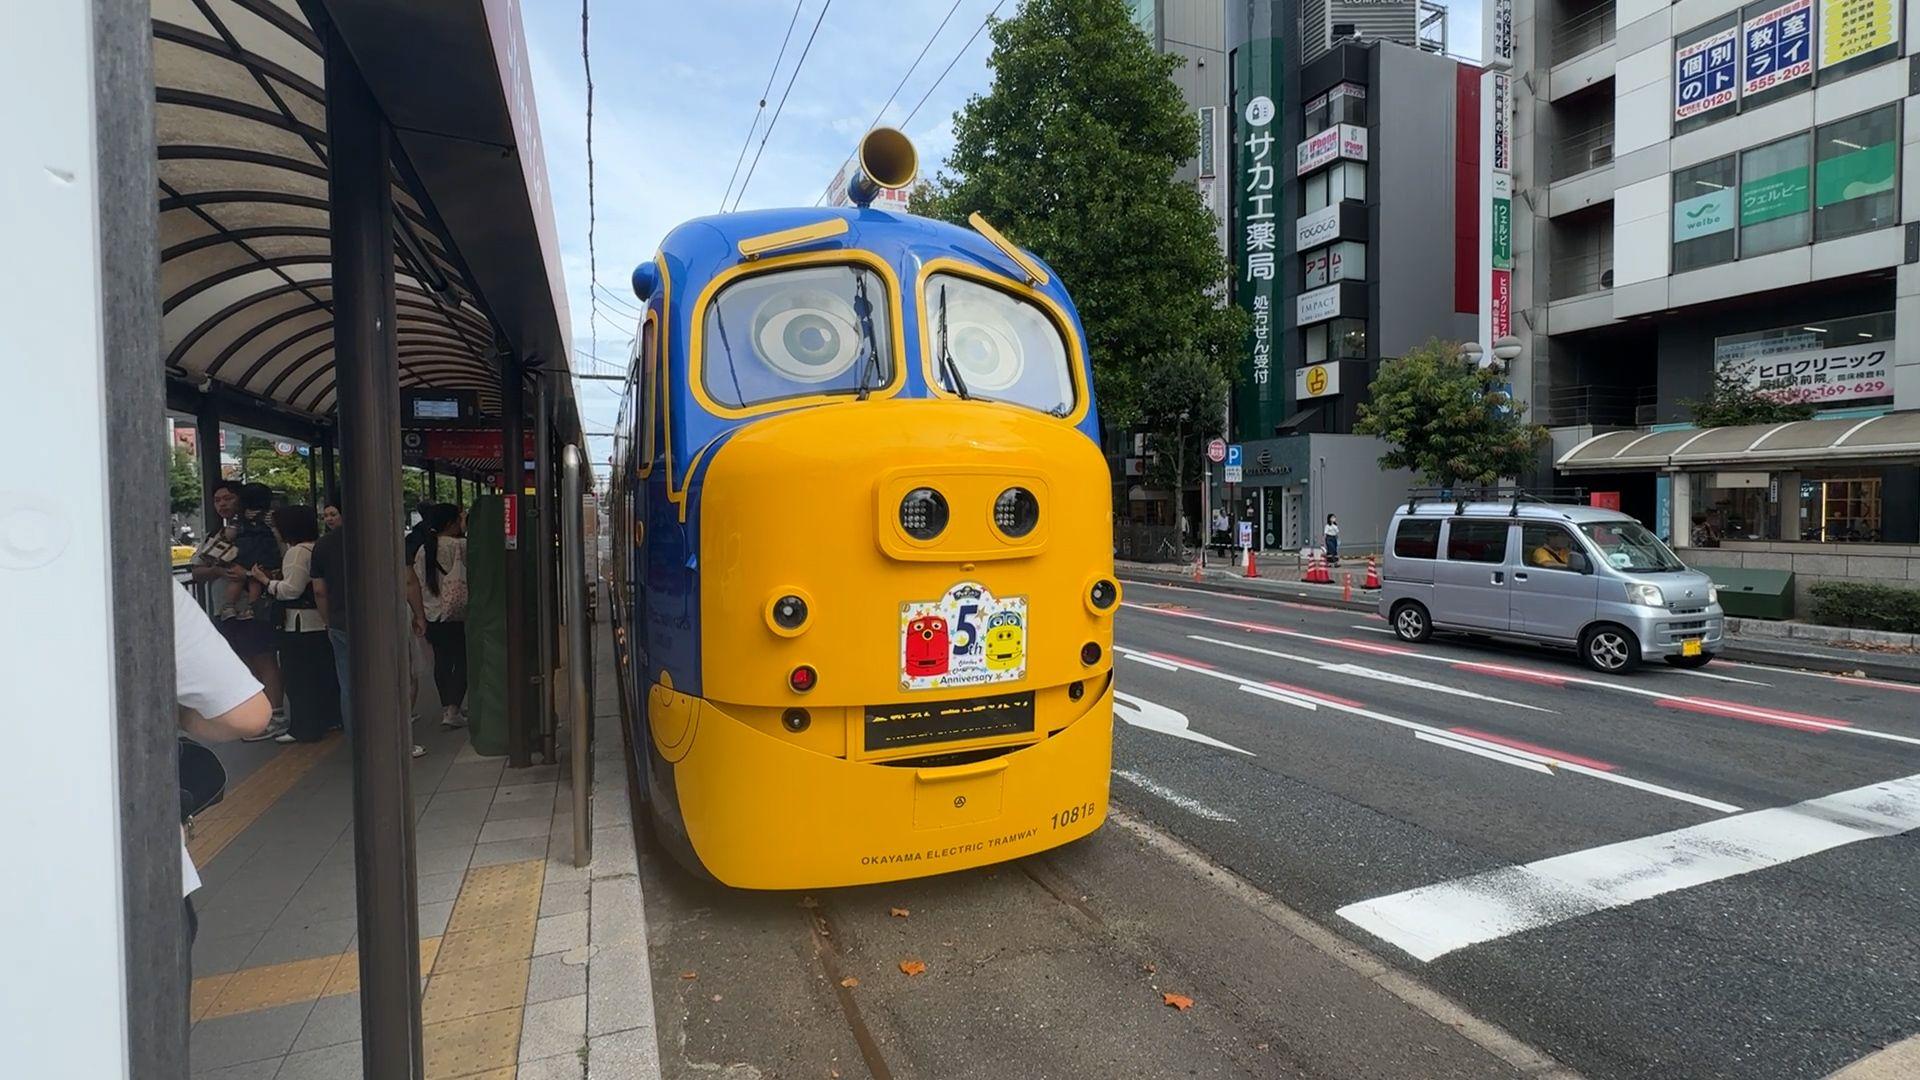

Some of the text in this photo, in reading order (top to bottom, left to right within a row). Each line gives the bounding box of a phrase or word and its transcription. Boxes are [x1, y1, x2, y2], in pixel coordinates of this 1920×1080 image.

[1703, 91, 1732, 109] 0120
[1245, 131, 1276, 283] サカエ薬局
[1745, 184, 1807, 208] ウェルビー
[1687, 217, 1720, 230] welbe
[1306, 253, 1342, 274] アコム
[1301, 297, 1336, 313] IMPACT
[1253, 295, 1270, 384] 処方せん受付
[1760, 350, 1886, 379] ヒロクリニック
[1229, 447, 1239, 464] P
[940, 673, 993, 685] Anniversary
[1051, 802, 1095, 830] 1081B
[861, 828, 1039, 866] OKAYAMA ELECTRIC TRAMWAY
